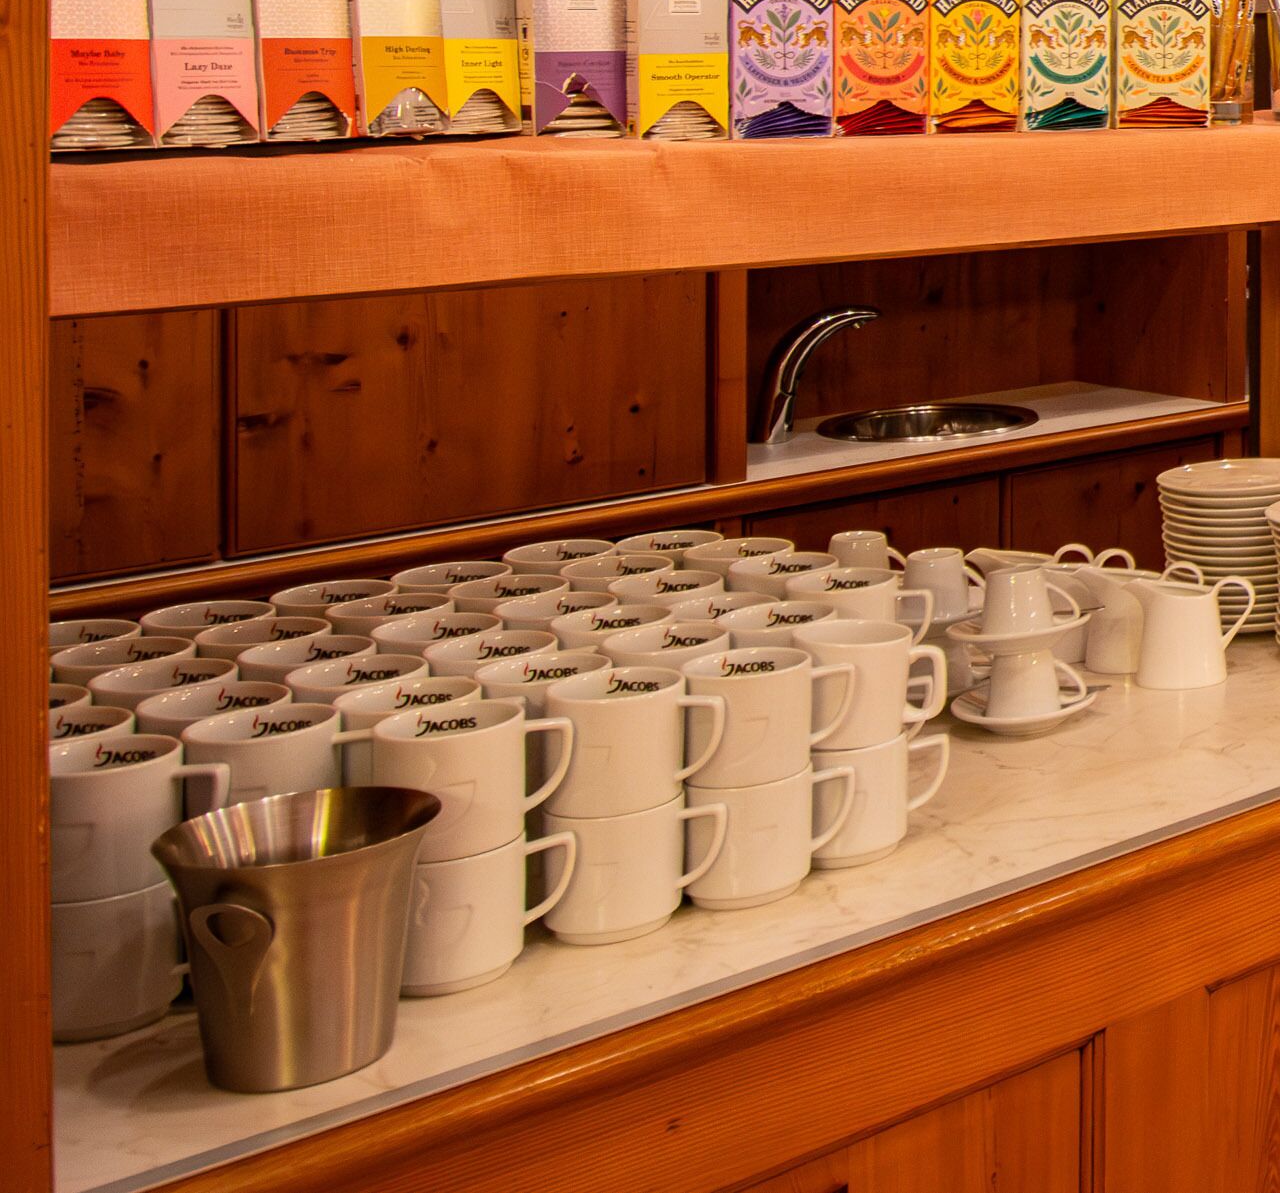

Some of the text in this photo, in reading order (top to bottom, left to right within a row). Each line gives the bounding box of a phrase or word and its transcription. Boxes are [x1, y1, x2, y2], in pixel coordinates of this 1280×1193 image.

[384, 45, 404, 55] High
[184, 62, 233, 73] Lazy Daze
[461, 59, 503, 68] Inner Light
[651, 73, 720, 81] Smooth Operator
[768, 563, 813, 575] JACOBS
[824, 579, 871, 591] JACOBS
[592, 617, 641, 631] JACOBS
[766, 614, 814, 627] JACOBS
[721, 661, 775, 677] JACOBS
[606, 680, 660, 694] JACOBS
[415, 717, 477, 737] JACOBS
